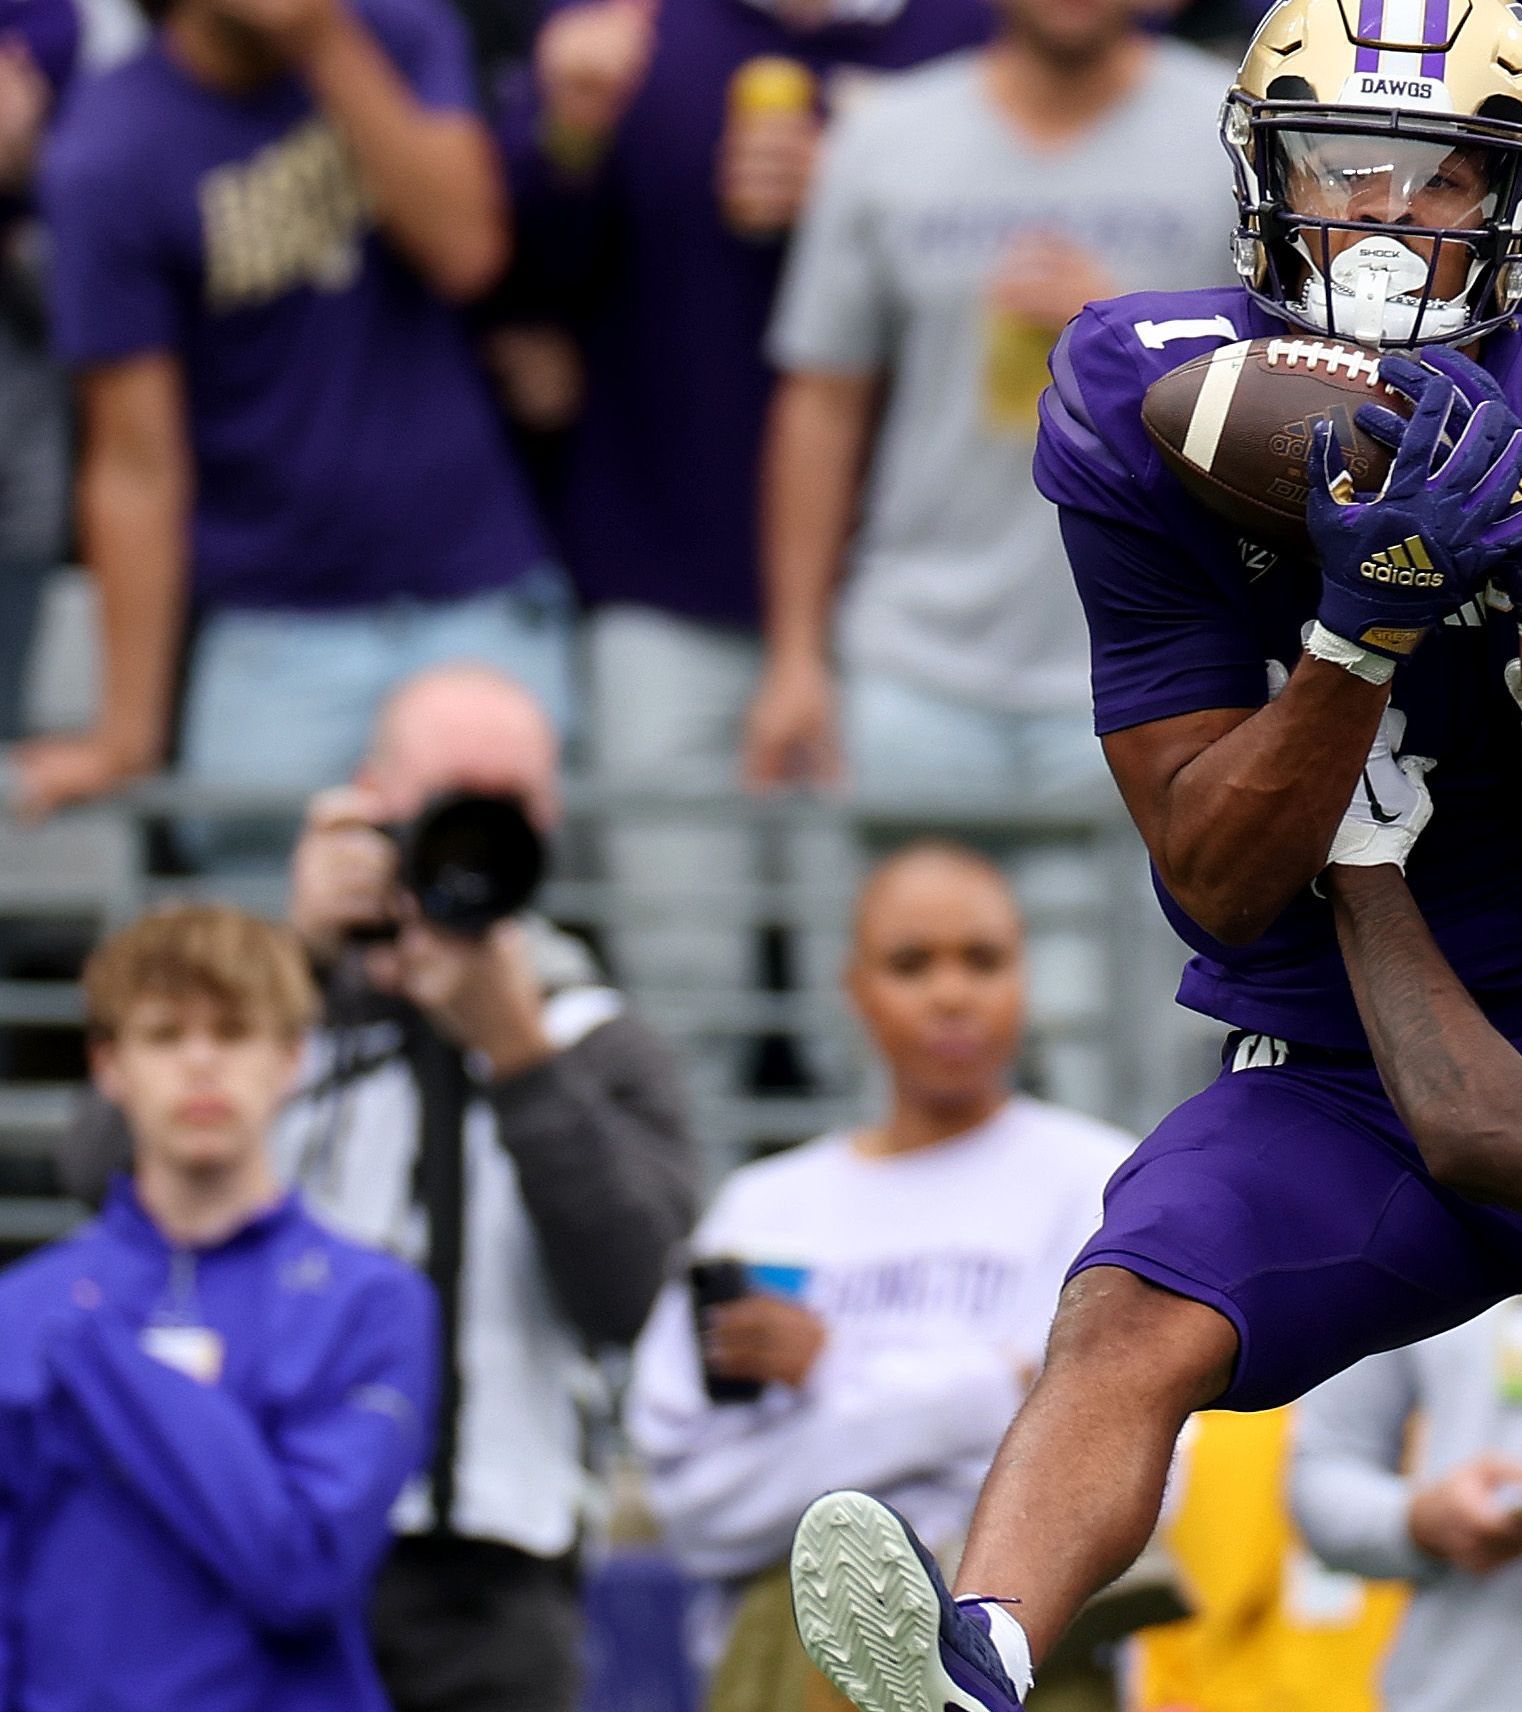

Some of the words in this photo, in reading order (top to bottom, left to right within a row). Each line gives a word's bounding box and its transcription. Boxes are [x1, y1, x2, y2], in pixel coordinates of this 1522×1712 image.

[1360, 78, 1432, 100] DAWGS
[1359, 248, 1401, 258] SHOCK
[1134, 315, 1239, 349] 1
[1360, 561, 1445, 587] adidas
